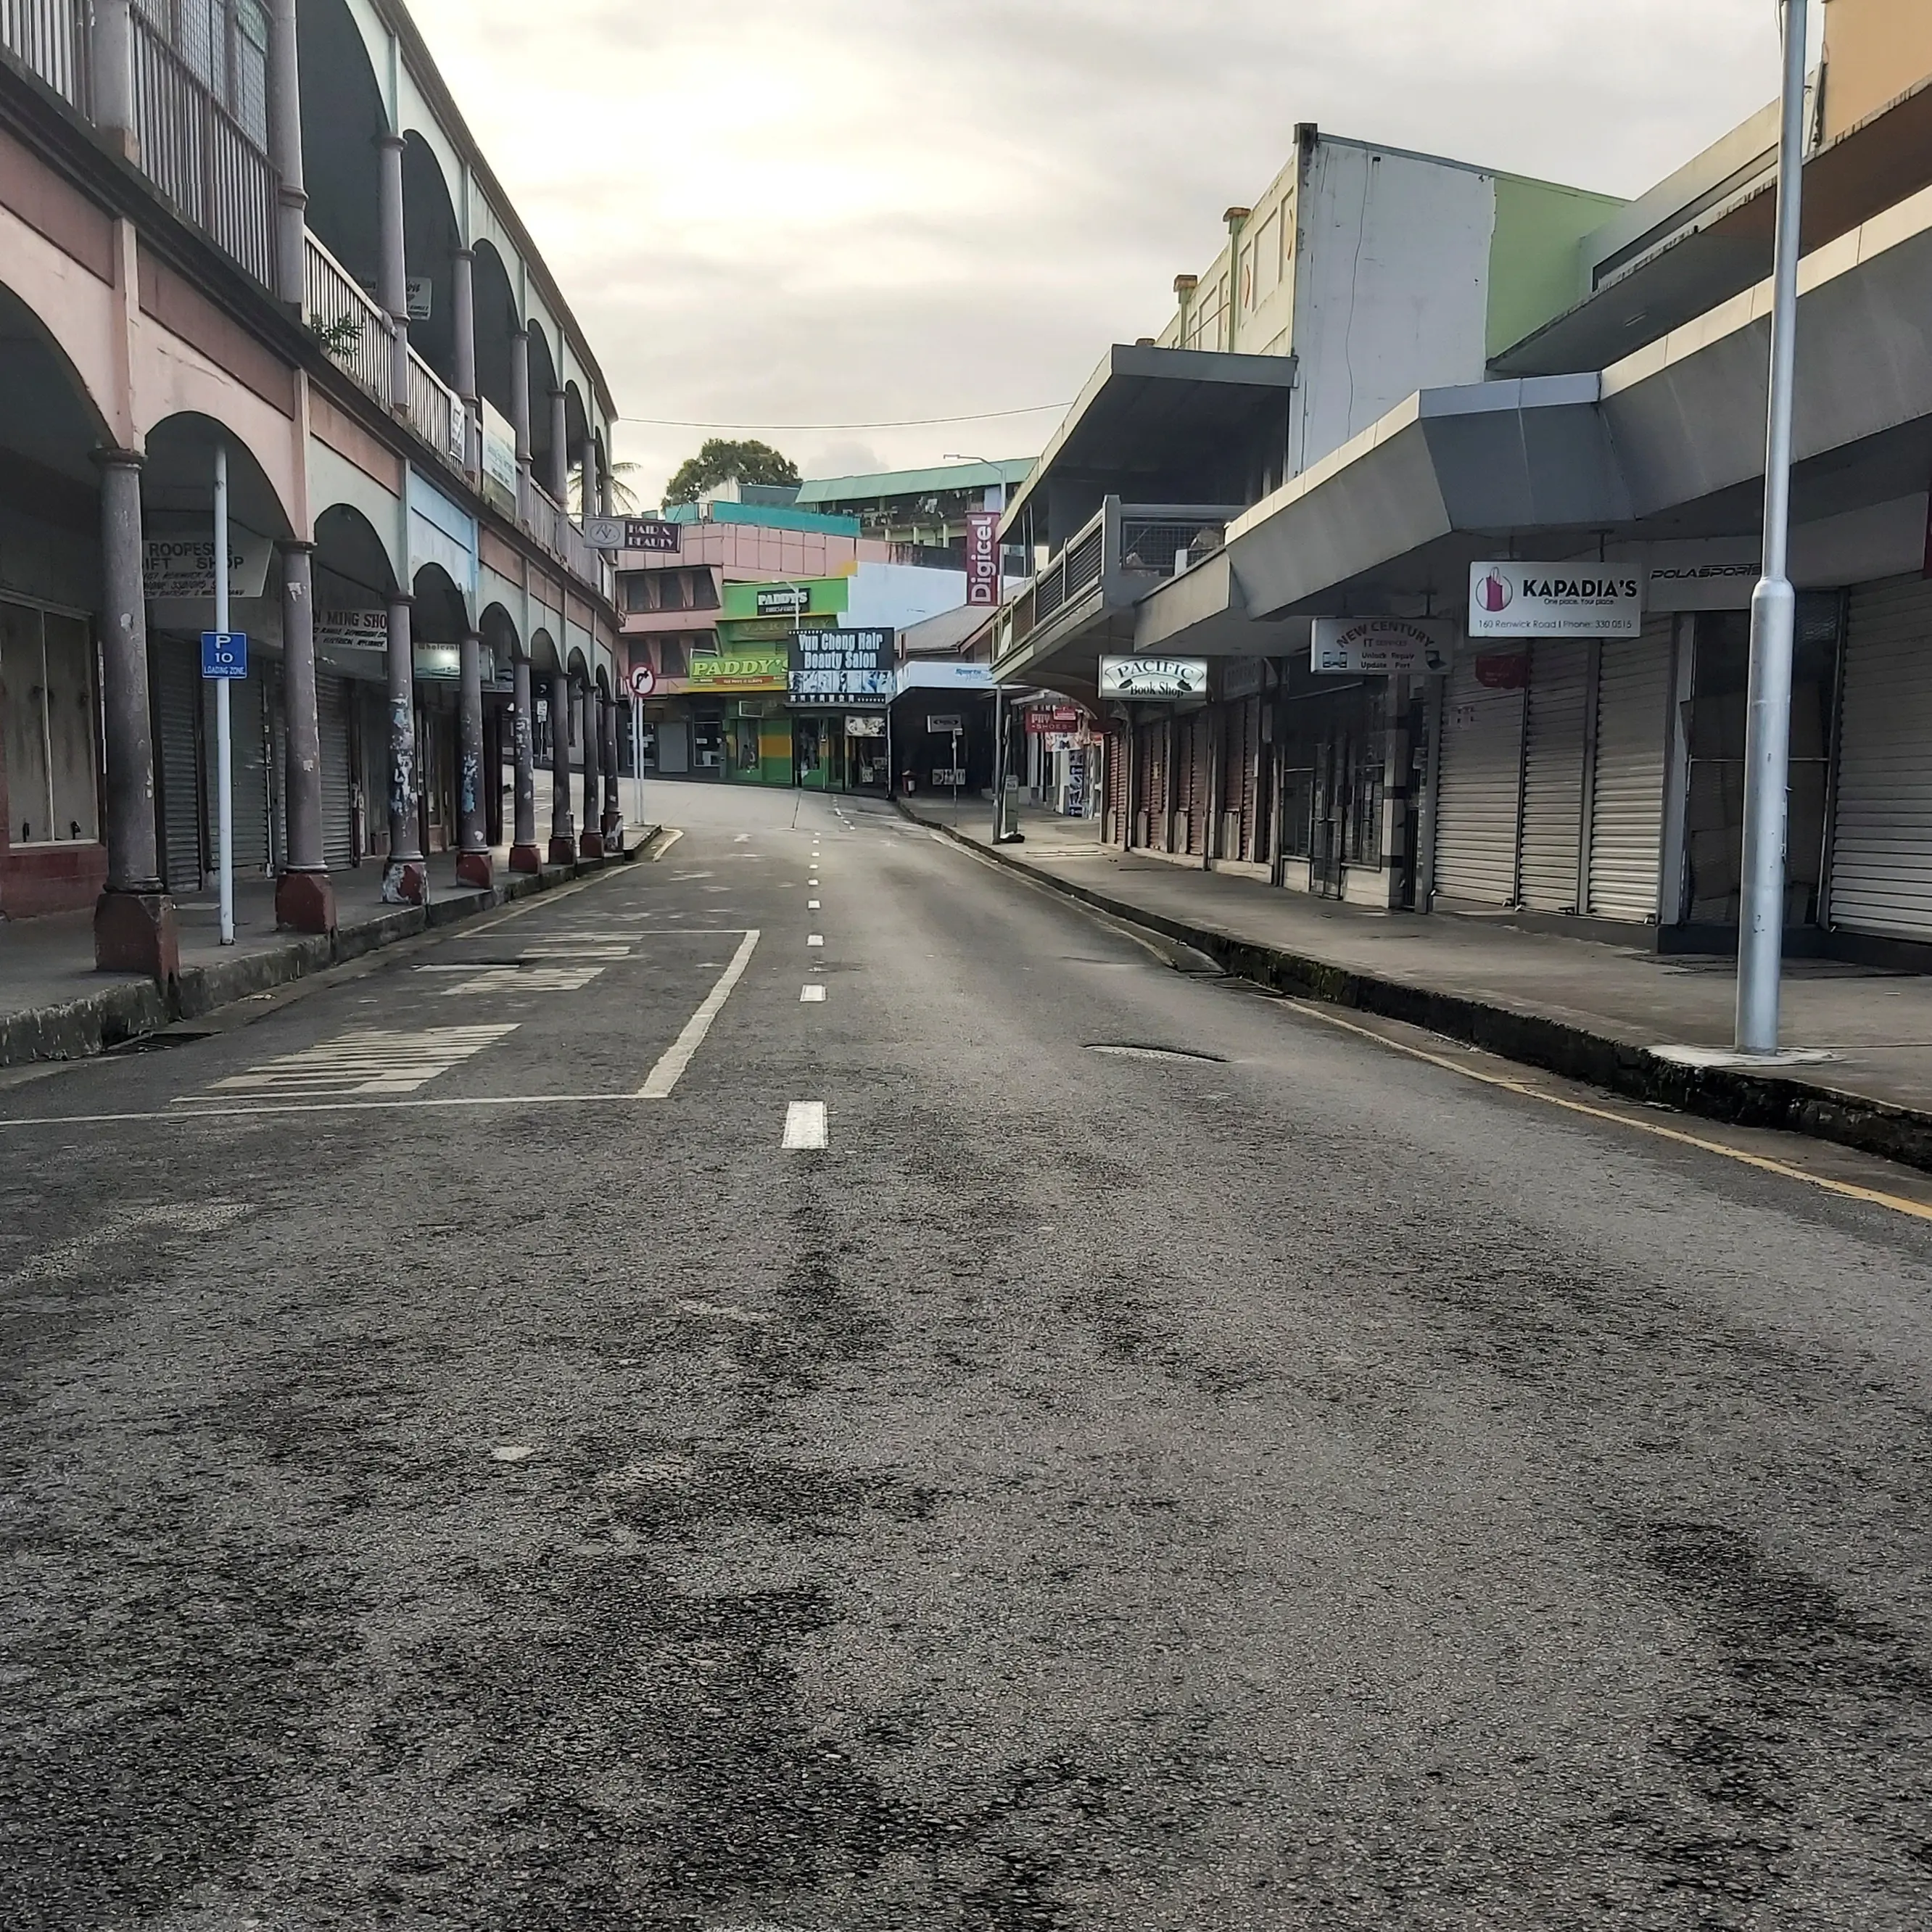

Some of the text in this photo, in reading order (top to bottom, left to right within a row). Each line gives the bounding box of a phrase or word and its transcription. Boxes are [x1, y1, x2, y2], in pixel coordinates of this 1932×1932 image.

[628, 524, 659, 534] HAIR
[149, 542, 233, 556] ROOPESS
[628, 537, 674, 548] BEAUTY
[143, 557, 173, 570] IFT
[971, 517, 996, 602] Digicel
[1523, 579, 1637, 597] KAPADIA'S
[326, 611, 360, 627] MING
[215, 635, 231, 649] P
[798, 633, 819, 651] Yun
[858, 632, 883, 650] Hair
[1336, 621, 1435, 648] NEW CENTURY
[1363, 637, 1374, 647] IT
[215, 653, 234, 663] 10
[804, 651, 877, 669] Beauty Salon
[1391, 652, 1415, 661] Repair
[229, 666, 245, 674] ZONE
[693, 659, 788, 677] PADDY'S
[1117, 659, 1194, 680] PACIFIC
[1131, 680, 1184, 698] Book Shop
